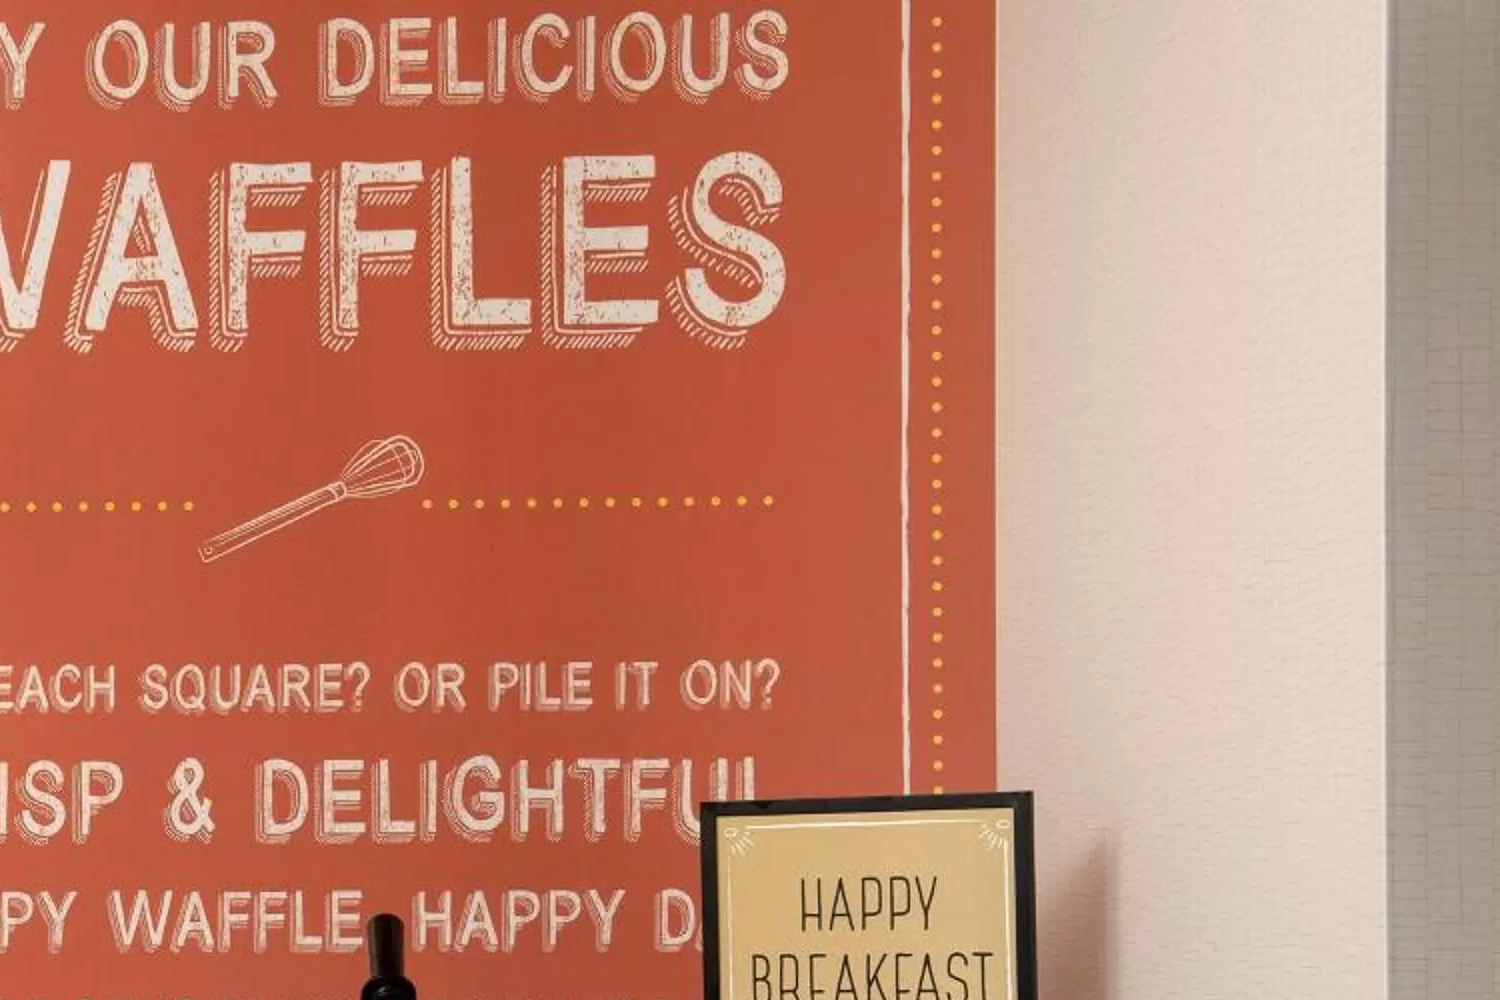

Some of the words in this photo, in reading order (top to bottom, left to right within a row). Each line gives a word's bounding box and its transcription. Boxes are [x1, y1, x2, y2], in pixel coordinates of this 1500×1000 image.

[86, 19, 278, 112] OUR
[315, 10, 790, 108] DELICIOUS
[137, 661, 372, 715] SQUARE?
[394, 662, 467, 713] OR
[488, 661, 594, 712] PILE
[615, 661, 659, 710] IT
[680, 658, 782, 710] ON?
[163, 756, 217, 845] &
[106, 889, 368, 954] WAFFLE
[411, 889, 626, 953] HAPPY
[800, 875, 938, 932] HAPPY
